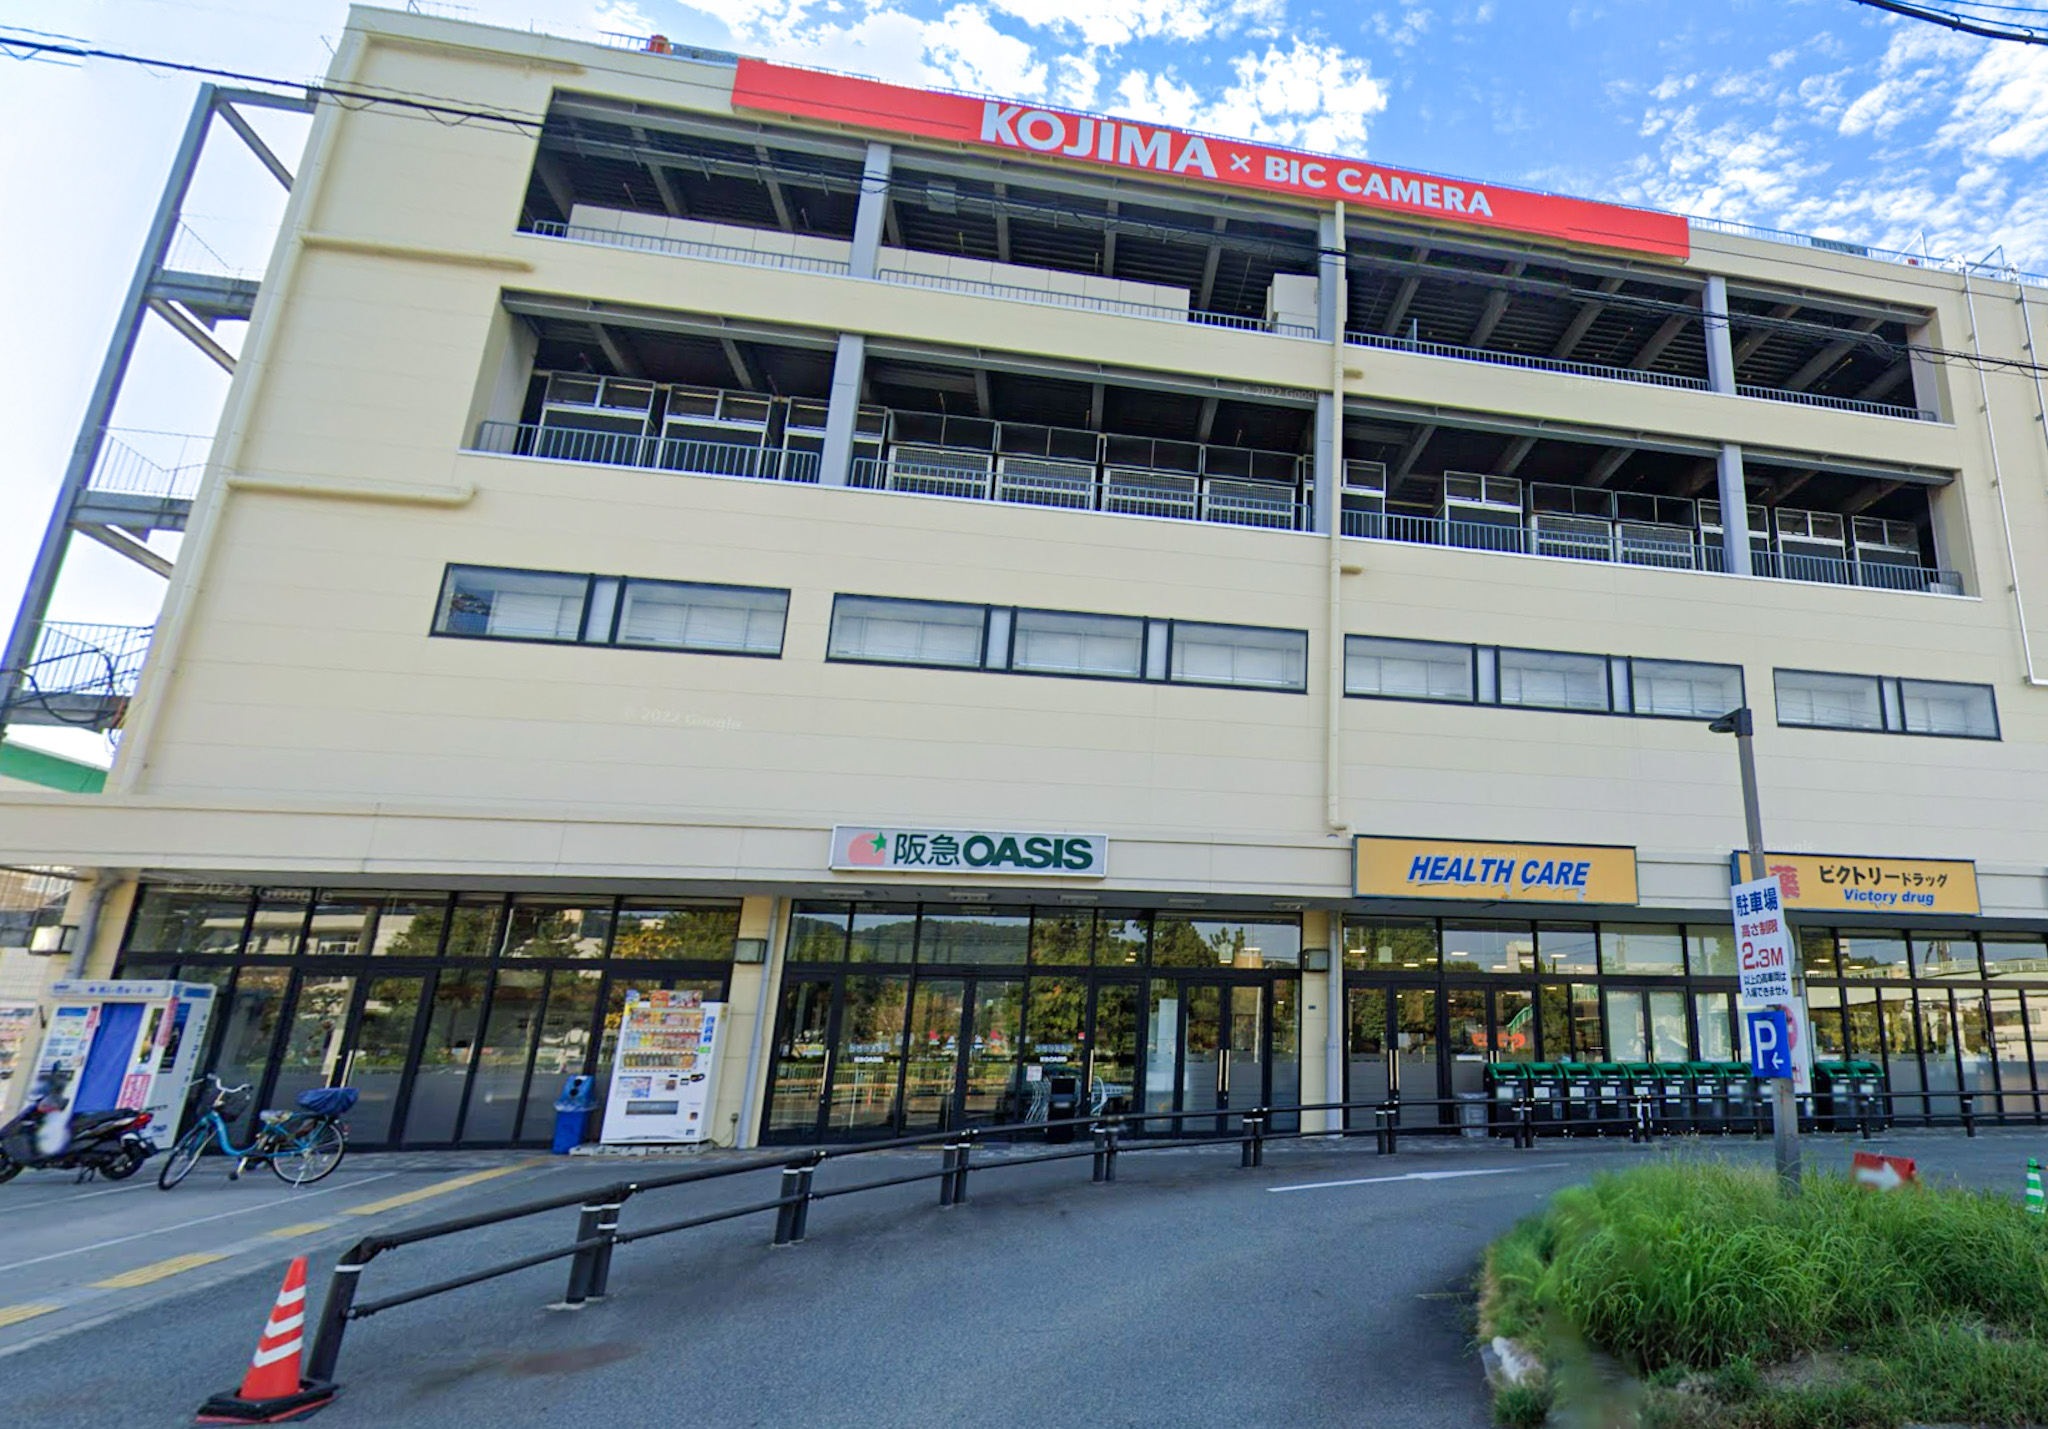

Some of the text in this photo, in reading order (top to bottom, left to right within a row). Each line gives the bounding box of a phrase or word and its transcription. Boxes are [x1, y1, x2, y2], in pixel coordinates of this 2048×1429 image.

[980, 102, 1218, 179] KOJIMA
[1264, 154, 1328, 189] BIC
[1335, 166, 1494, 218] CAMERA
[1407, 856, 1591, 886] HEALTH CARE
[1736, 887, 1778, 917] 駐車場
[1843, 888, 1935, 906] Victory drug
[1741, 918, 1779, 938] 高さ制限
[1741, 941, 1784, 970] 2.3M
[1753, 1020, 1778, 1070] P
